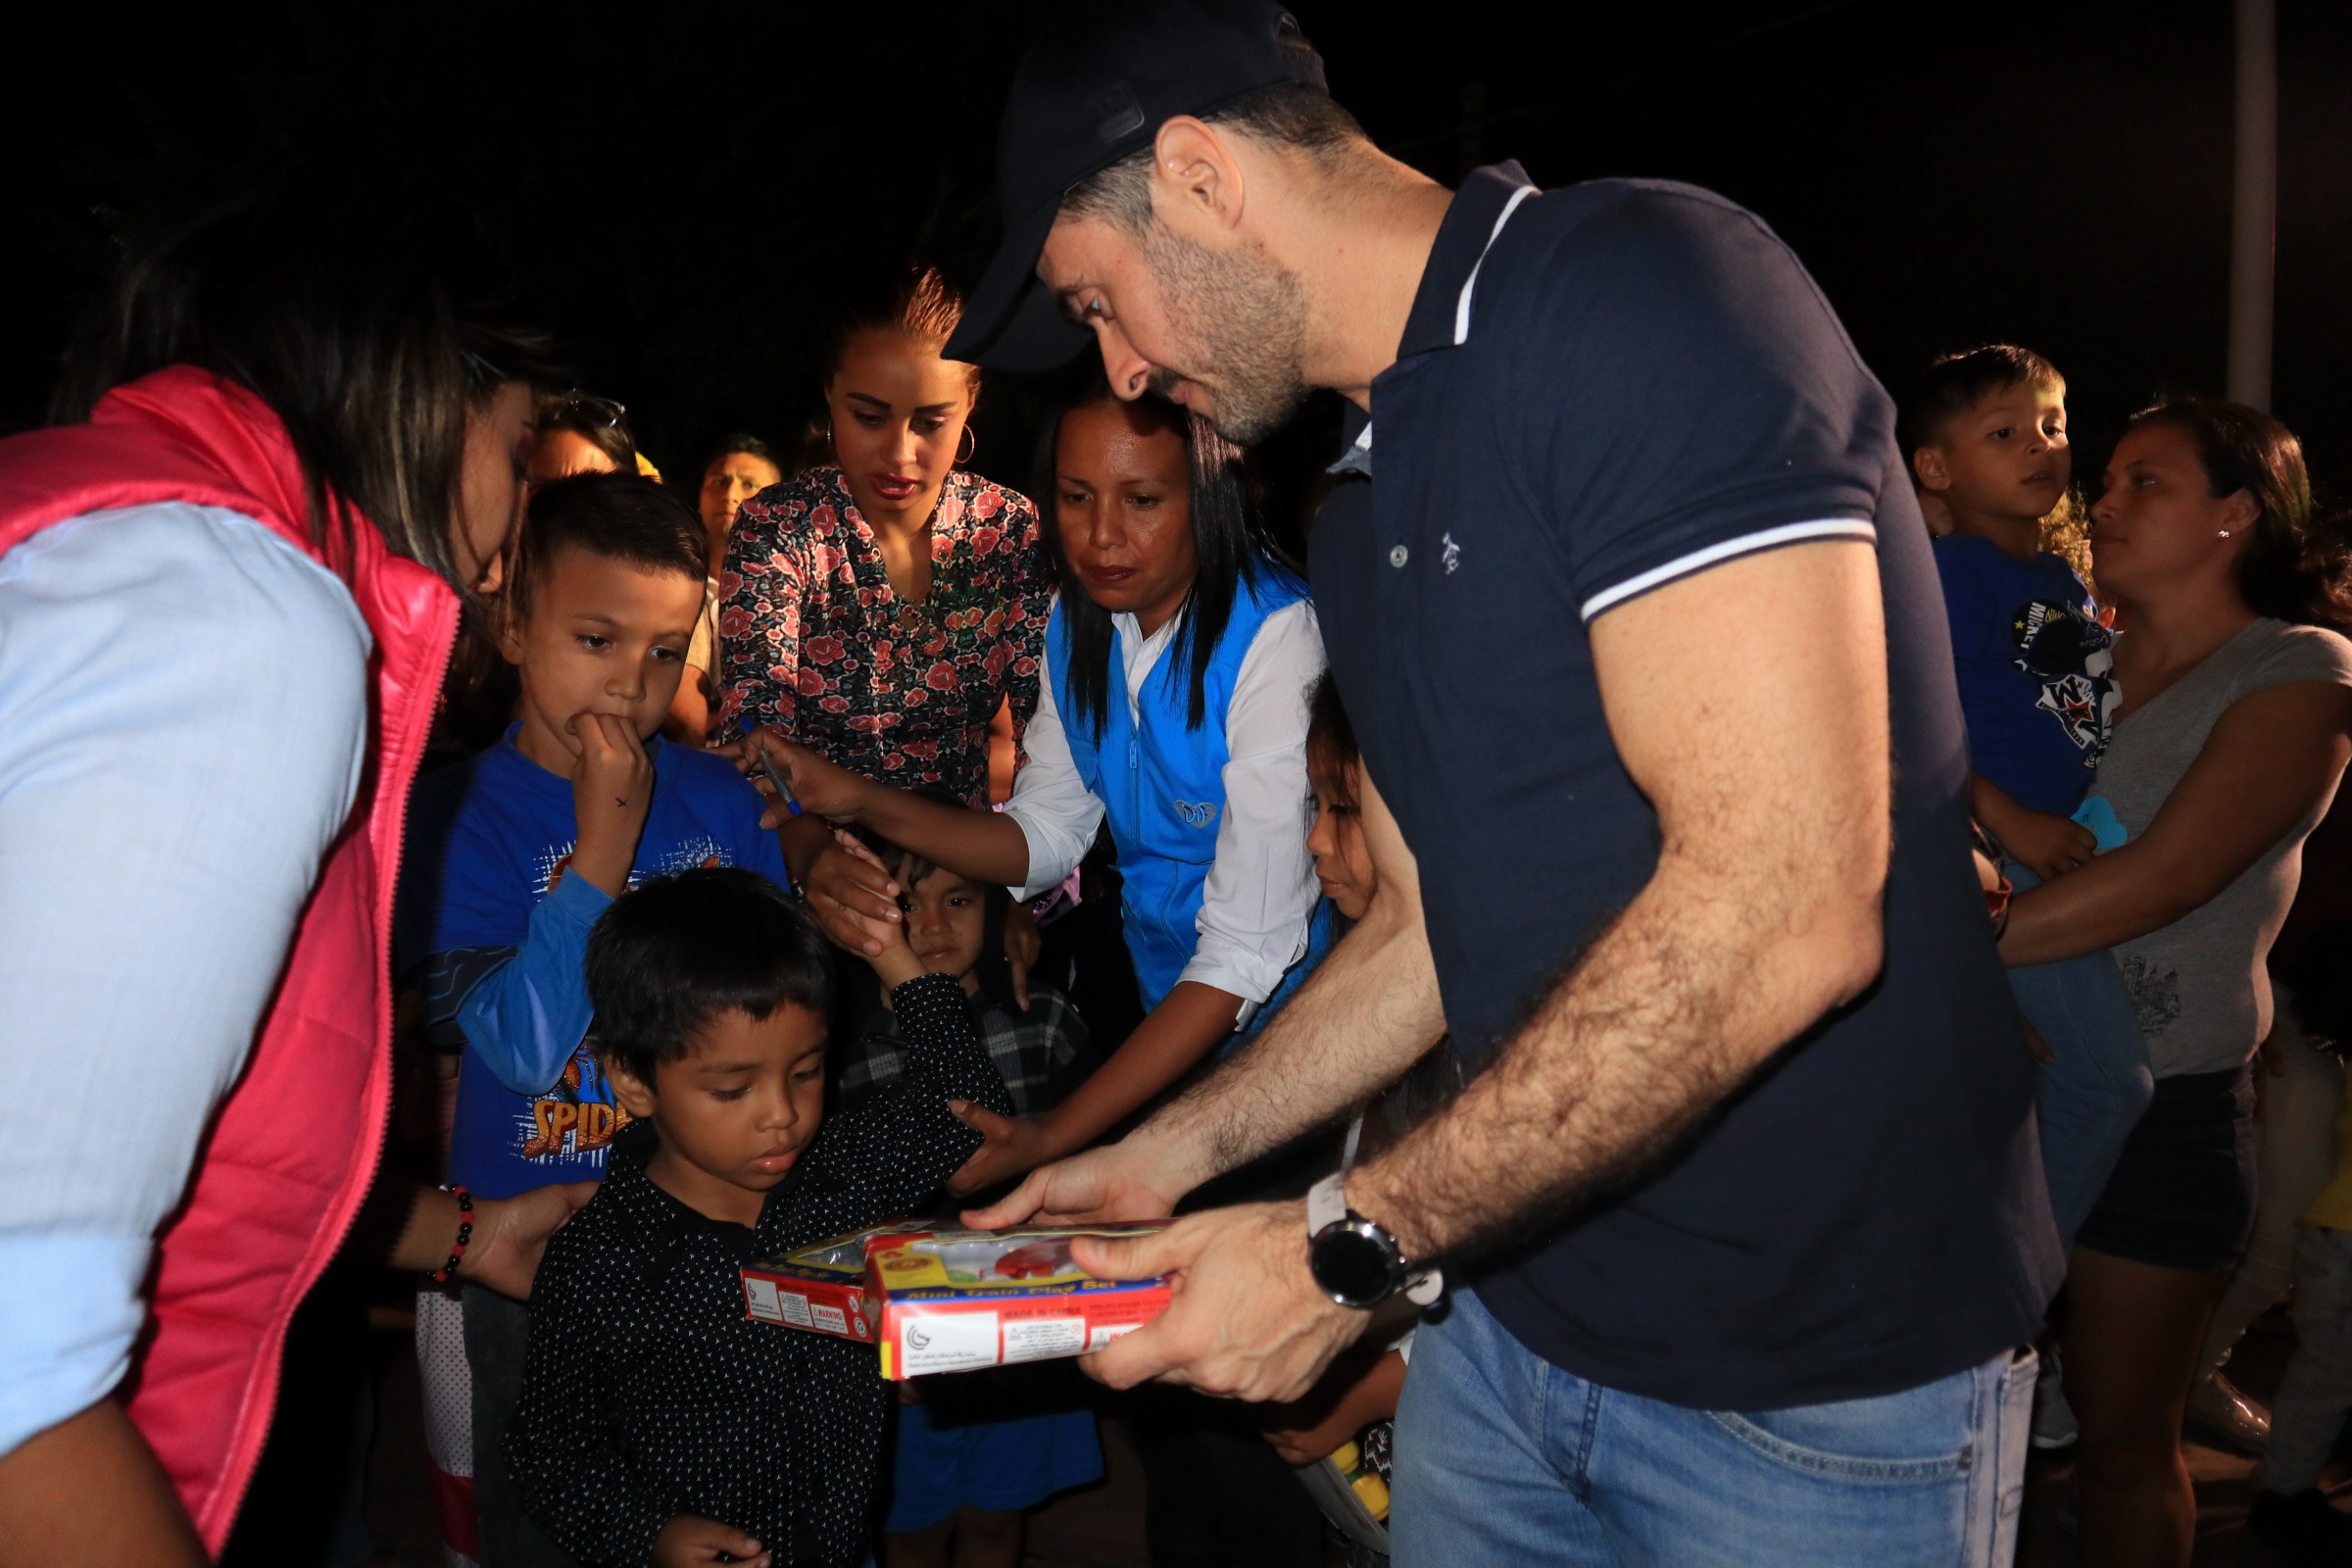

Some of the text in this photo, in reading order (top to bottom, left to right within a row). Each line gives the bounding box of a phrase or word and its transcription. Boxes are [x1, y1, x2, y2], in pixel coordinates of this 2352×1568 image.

[906, 1279, 1117, 1300] Mini Train Play Set
